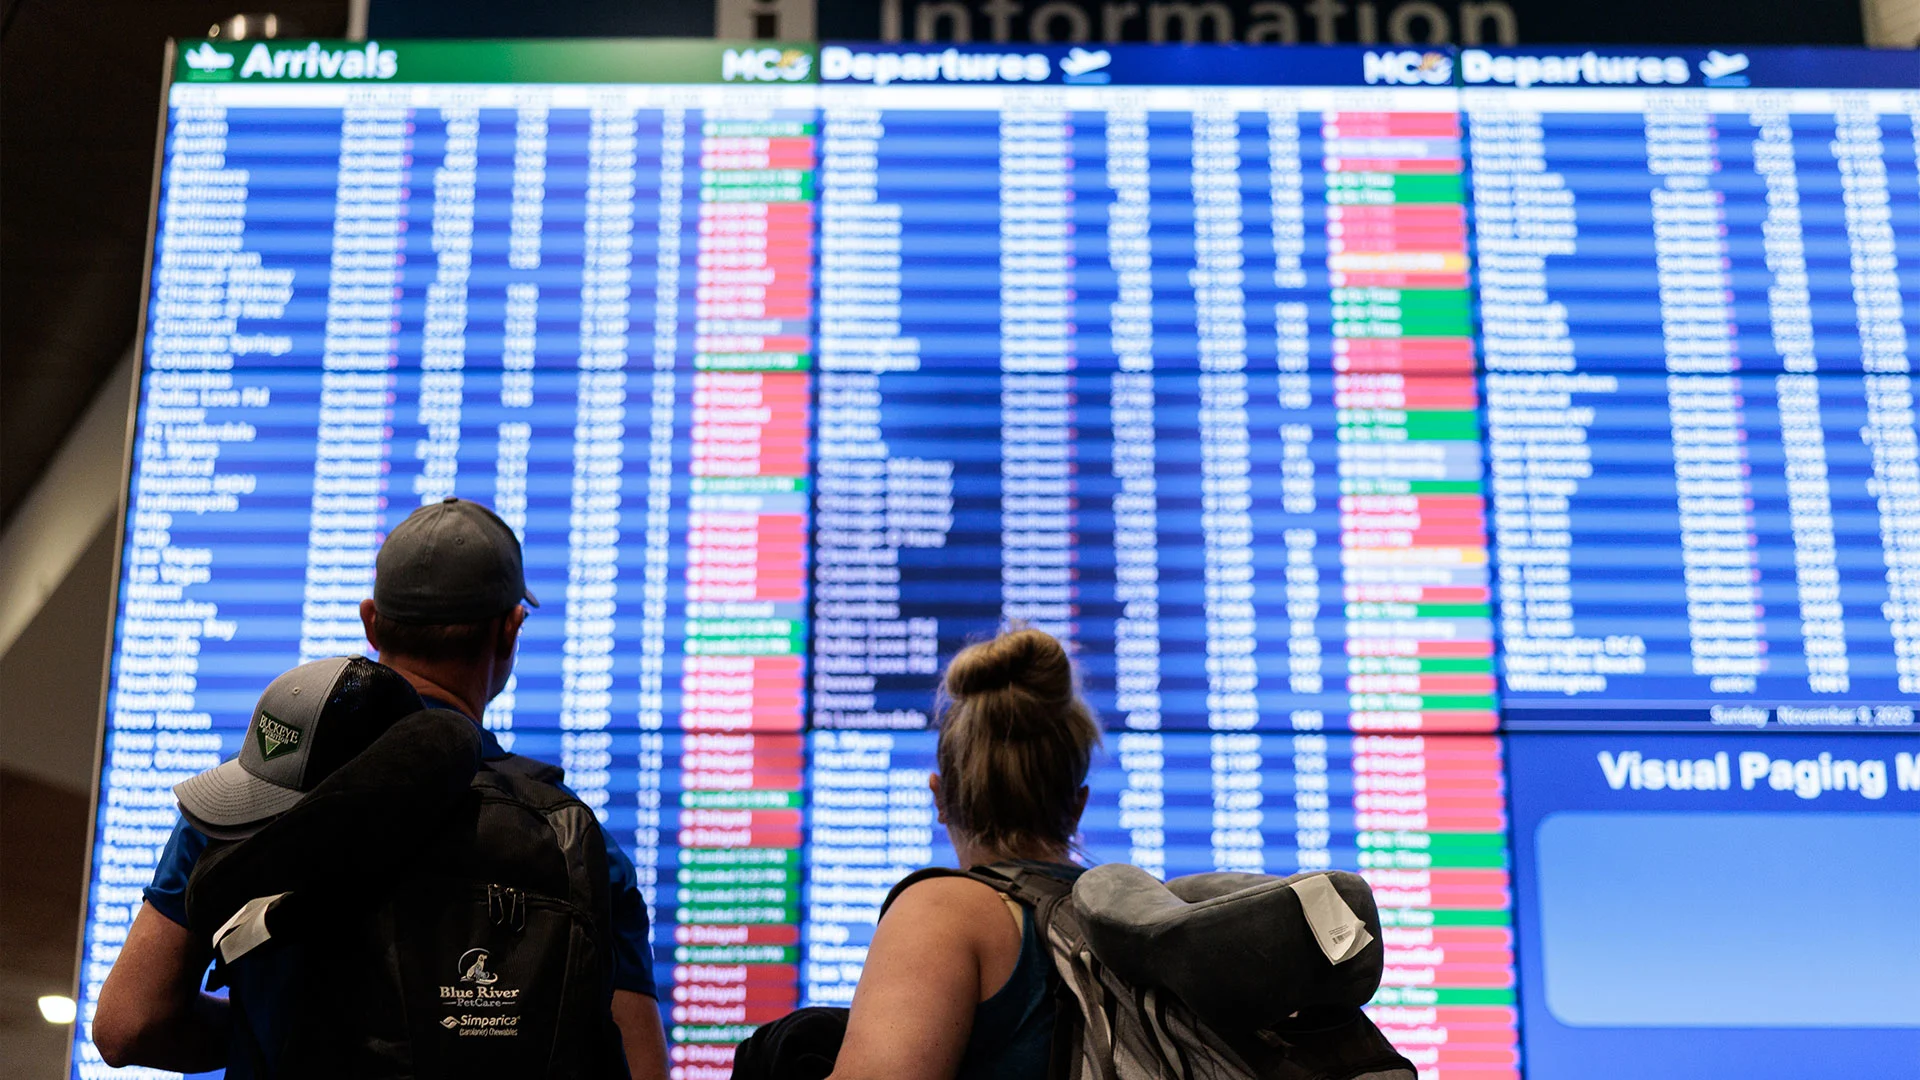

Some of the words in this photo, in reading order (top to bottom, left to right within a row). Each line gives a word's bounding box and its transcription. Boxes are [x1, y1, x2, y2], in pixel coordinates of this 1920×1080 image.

[880, 0, 1519, 45] Information
[240, 41, 398, 79] Arrivals
[820, 46, 1050, 85] Departures
[1461, 50, 1690, 87] Departures
[259, 714, 300, 744] BUCKEYE
[1710, 704, 1769, 728] Sunday
[1776, 704, 1856, 726] November
[1598, 751, 1731, 791] Visual
[1739, 752, 1888, 800] Paging
[439, 986, 474, 998] Blue
[477, 986, 520, 998] River
[457, 998, 502, 1007] PetCare
[460, 1014, 518, 1028] Simparica
